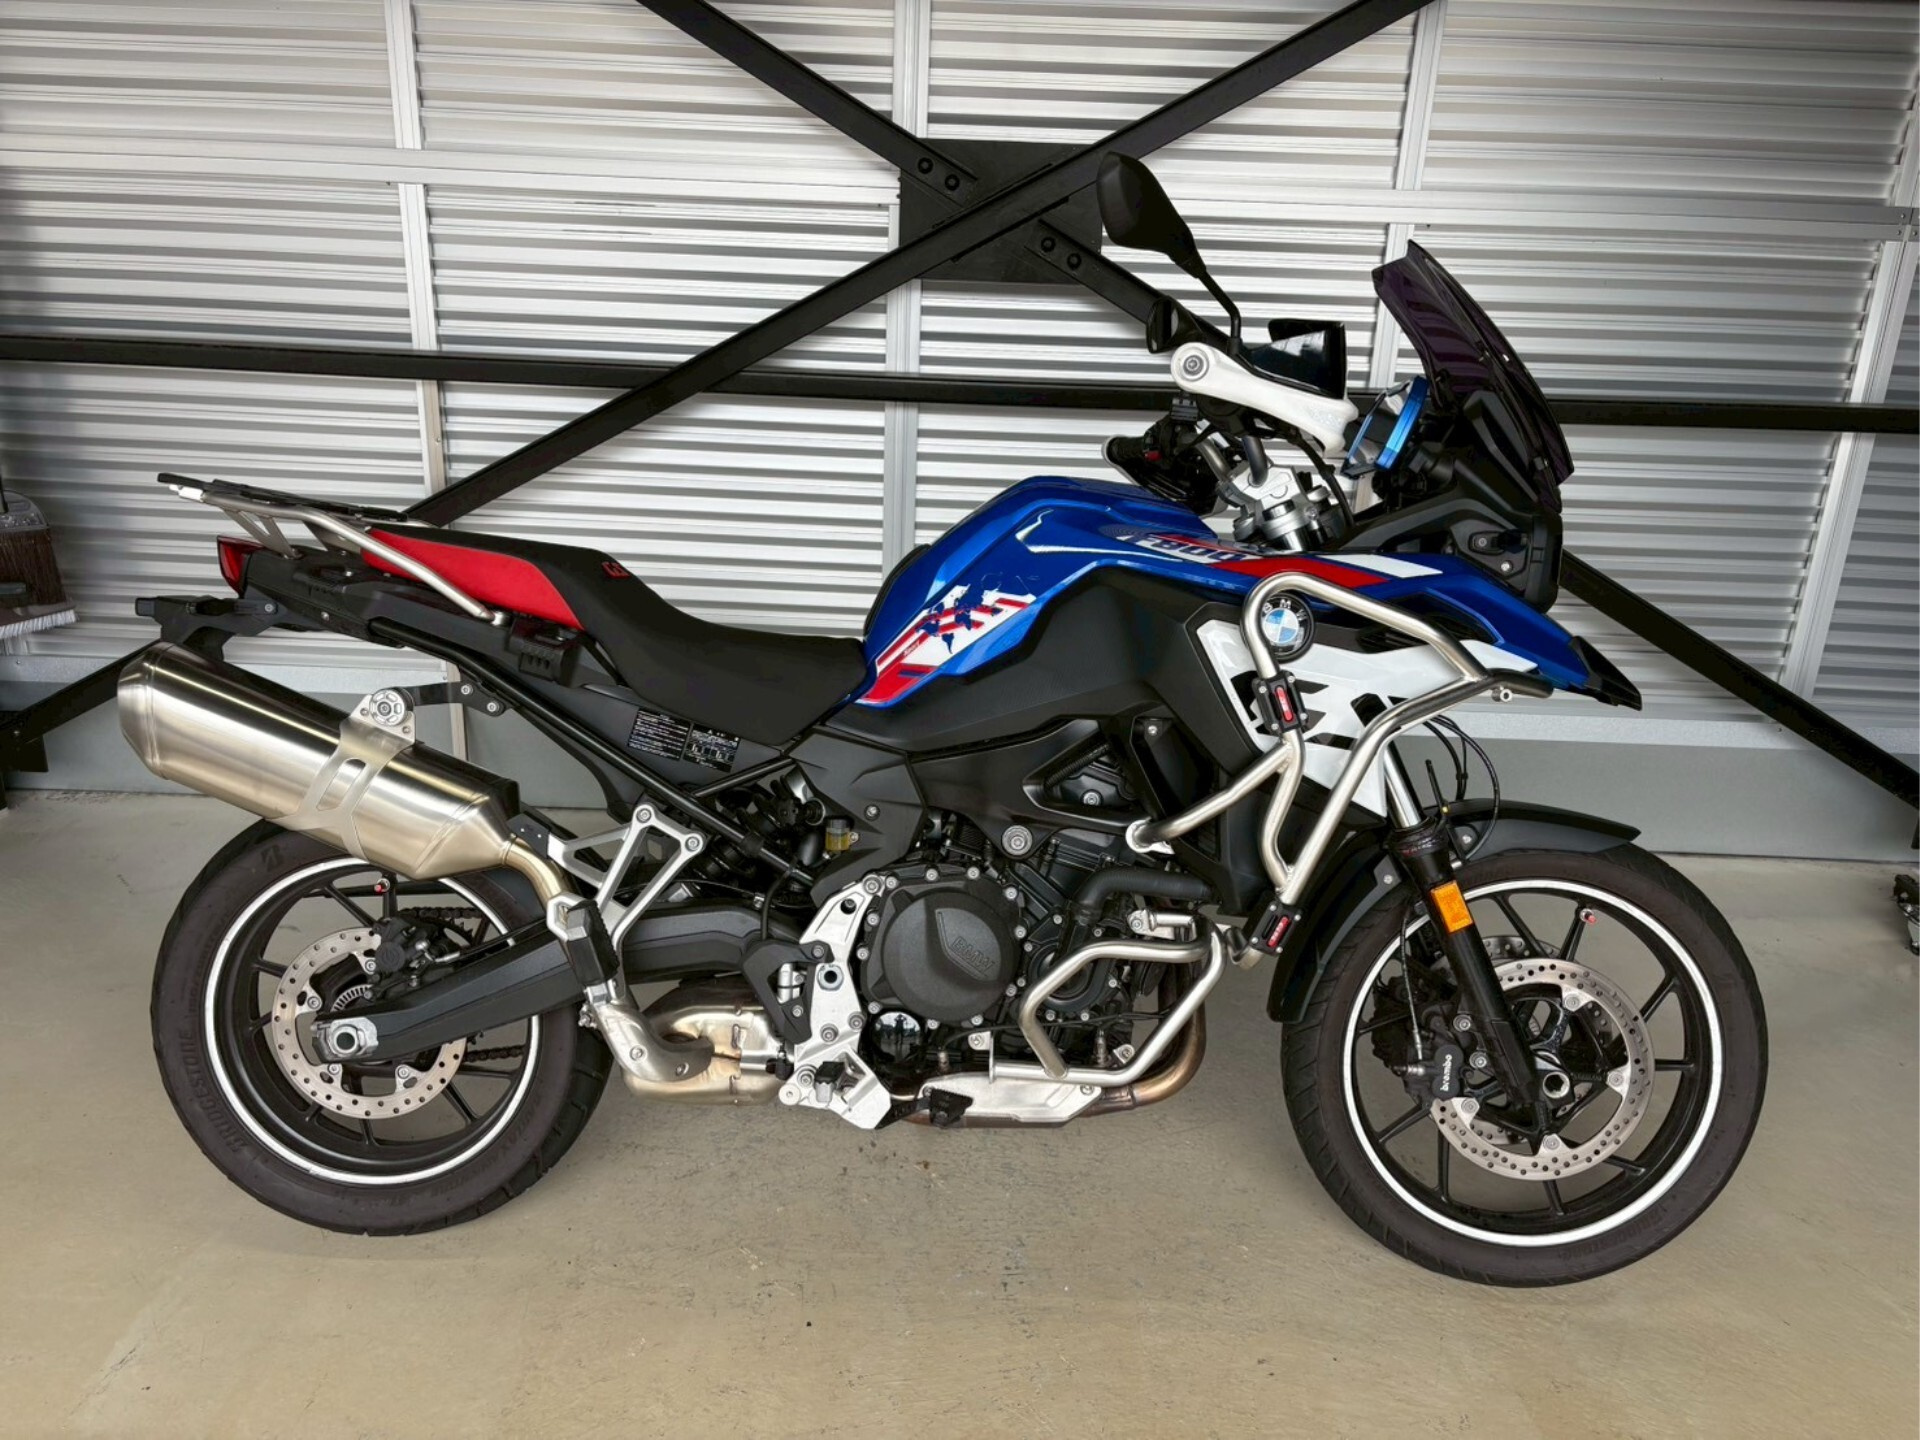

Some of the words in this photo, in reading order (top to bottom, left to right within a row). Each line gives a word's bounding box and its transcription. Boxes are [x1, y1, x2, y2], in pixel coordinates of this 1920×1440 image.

[1262, 599, 1307, 621] BMW
[952, 936, 995, 973] BMW
[1440, 1054, 1452, 1091] brembo
[179, 1031, 248, 1154] BRIDGESTONE
